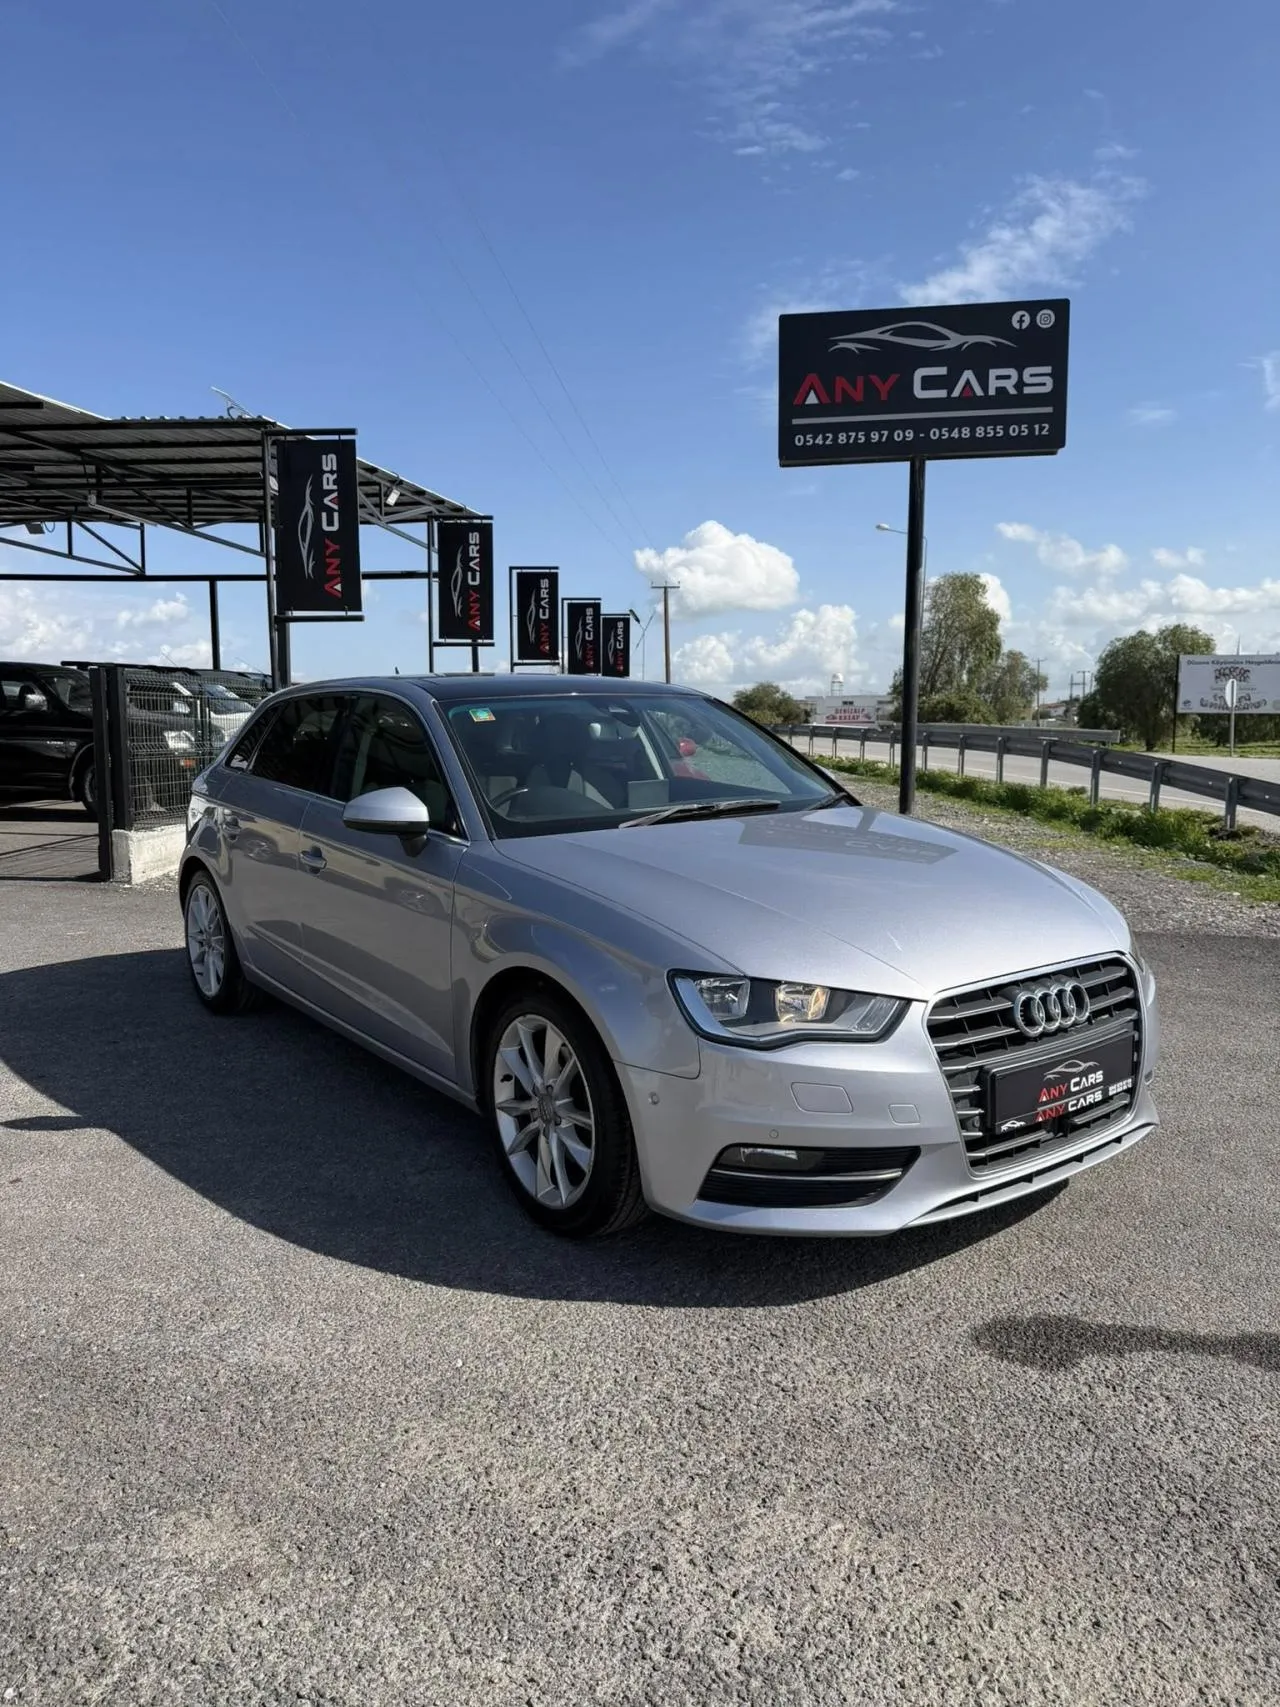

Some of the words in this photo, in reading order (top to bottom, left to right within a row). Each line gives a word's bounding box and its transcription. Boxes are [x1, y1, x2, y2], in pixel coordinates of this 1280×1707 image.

[793, 372, 900, 406] ANY
[913, 365, 1053, 399] CARS
[794, 433, 833, 446] 0542
[838, 431, 865, 444] 875
[870, 430, 888, 442] 97
[894, 429, 914, 441] 09
[930, 427, 970, 440] 0548
[975, 425, 1004, 437] 855
[1009, 424, 1028, 436] 05
[1033, 423, 1050, 435] 12
[321, 453, 340, 532] CARS
[323, 538, 342, 598] ANY
[467, 532, 480, 586] CARS
[468, 590, 481, 631] ANY
[539, 578, 549, 619] CARS
[539, 622, 550, 654] ANY
[585, 607, 593, 640] CARS
[616, 621, 624, 649] CARS
[1038, 1083, 1068, 1103] ANY
[1070, 1070, 1103, 1092] CARS
[1034, 1104, 1065, 1122] ANY
[1068, 1090, 1103, 1111] CARS
